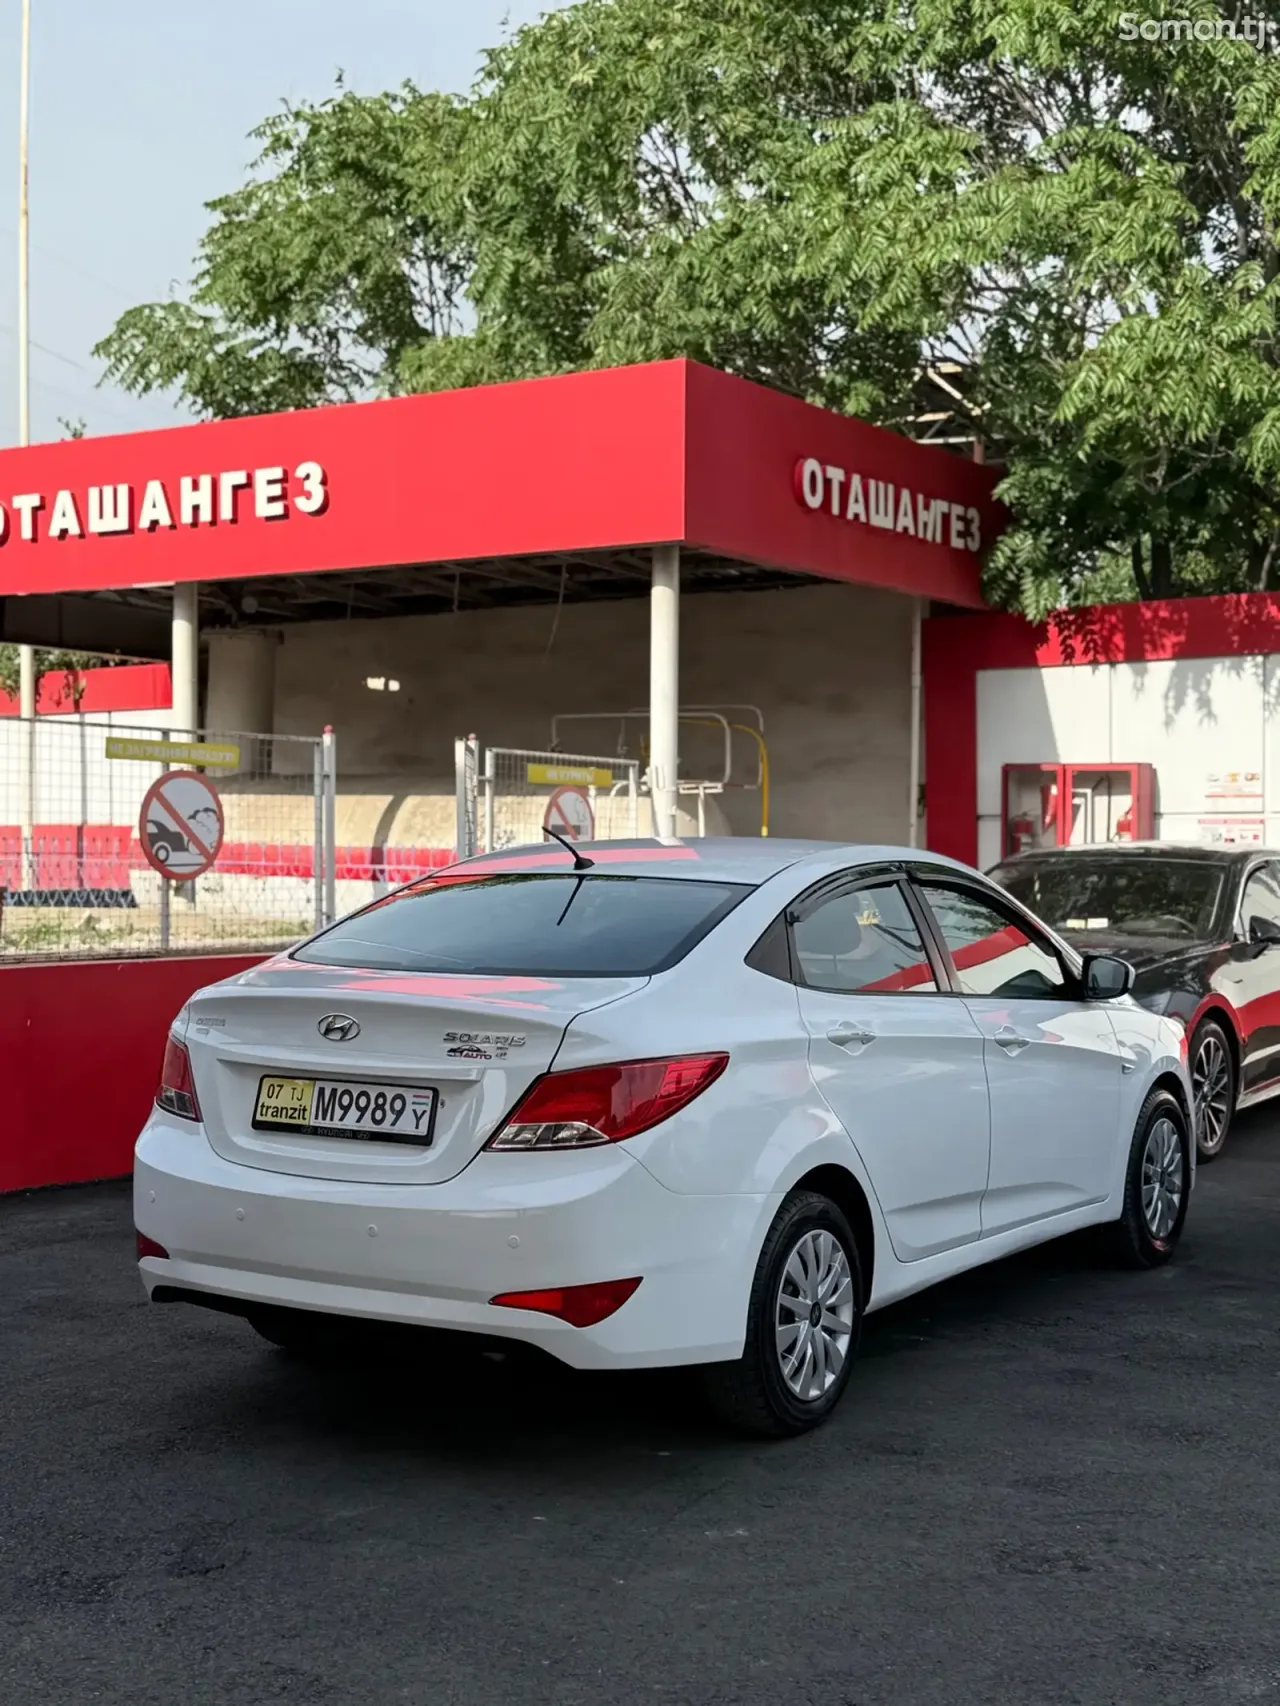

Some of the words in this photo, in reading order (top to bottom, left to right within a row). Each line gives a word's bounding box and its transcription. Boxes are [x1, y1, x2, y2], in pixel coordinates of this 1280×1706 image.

[0, 461, 326, 548] ТАШАНГЕЗ
[802, 458, 981, 552] ОТАШАНГЕЗ
[443, 1032, 526, 1047] SOLARIS
[462, 1050, 493, 1060] AUTO
[266, 1083, 284, 1100] 07
[290, 1087, 305, 1101] TJ
[260, 1101, 308, 1120] tranzit
[314, 1086, 407, 1127] M9989
[412, 1108, 428, 1130] Y
